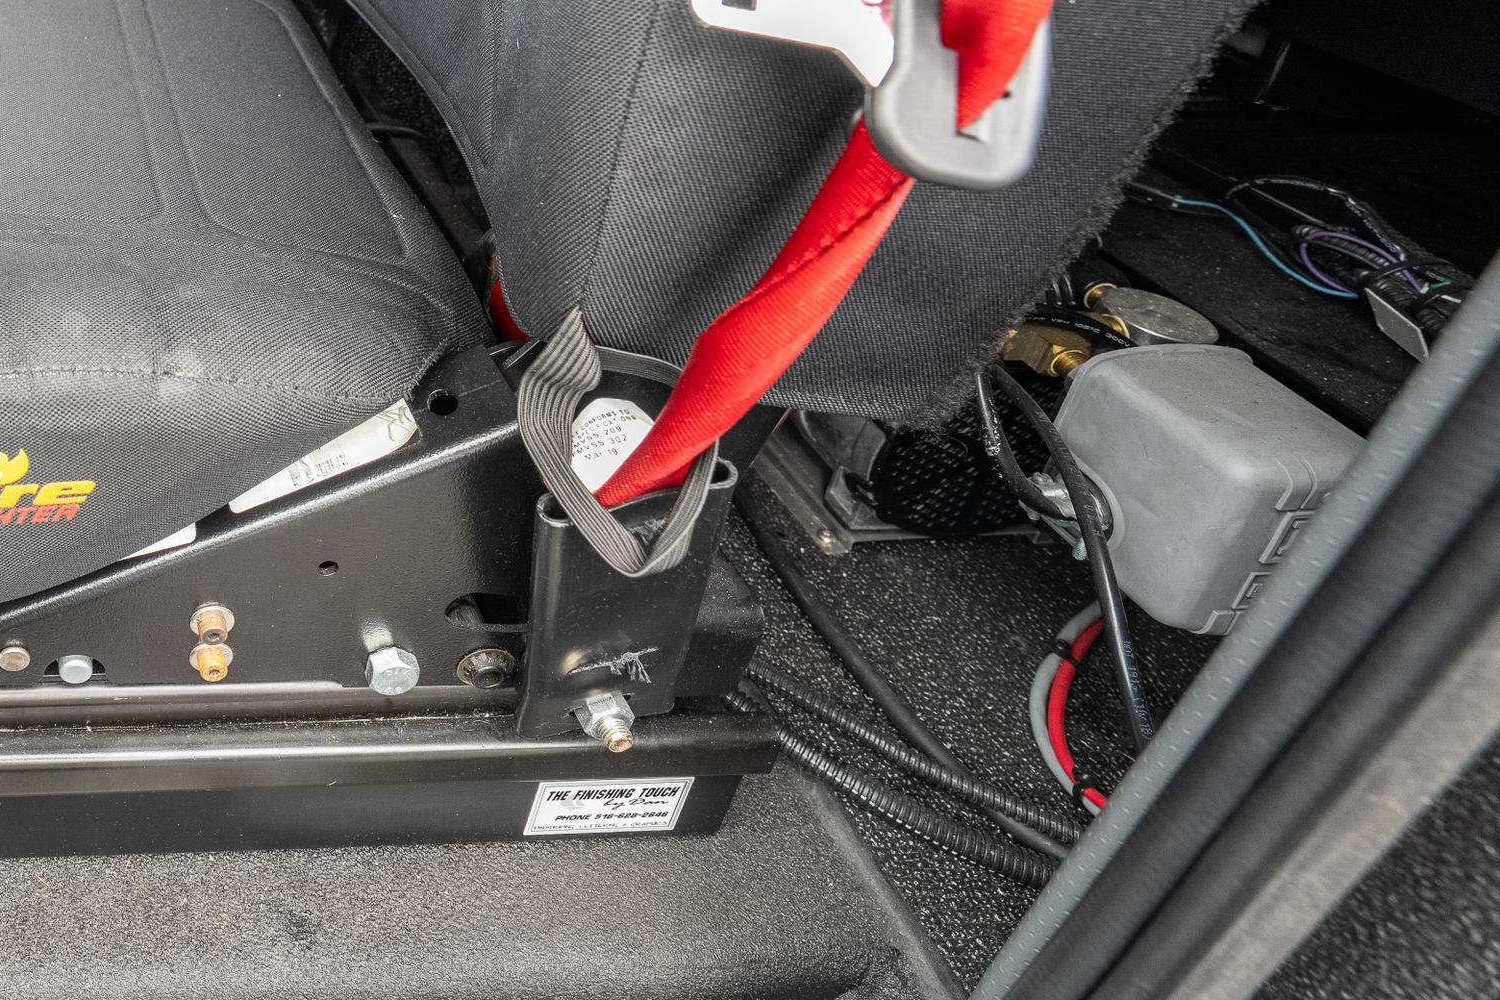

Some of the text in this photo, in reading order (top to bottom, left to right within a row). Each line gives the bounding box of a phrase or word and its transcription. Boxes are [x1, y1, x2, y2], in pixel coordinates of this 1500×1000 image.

[1104, 331, 1131, 348] 300V
[580, 411, 617, 431] CONFORMS
[572, 425, 622, 449] MVSS 209
[609, 433, 628, 445] 302
[546, 786, 681, 801] THE FINISHING TOUCH
[603, 797, 669, 811] by Dan
[554, 813, 591, 822] PHONE
